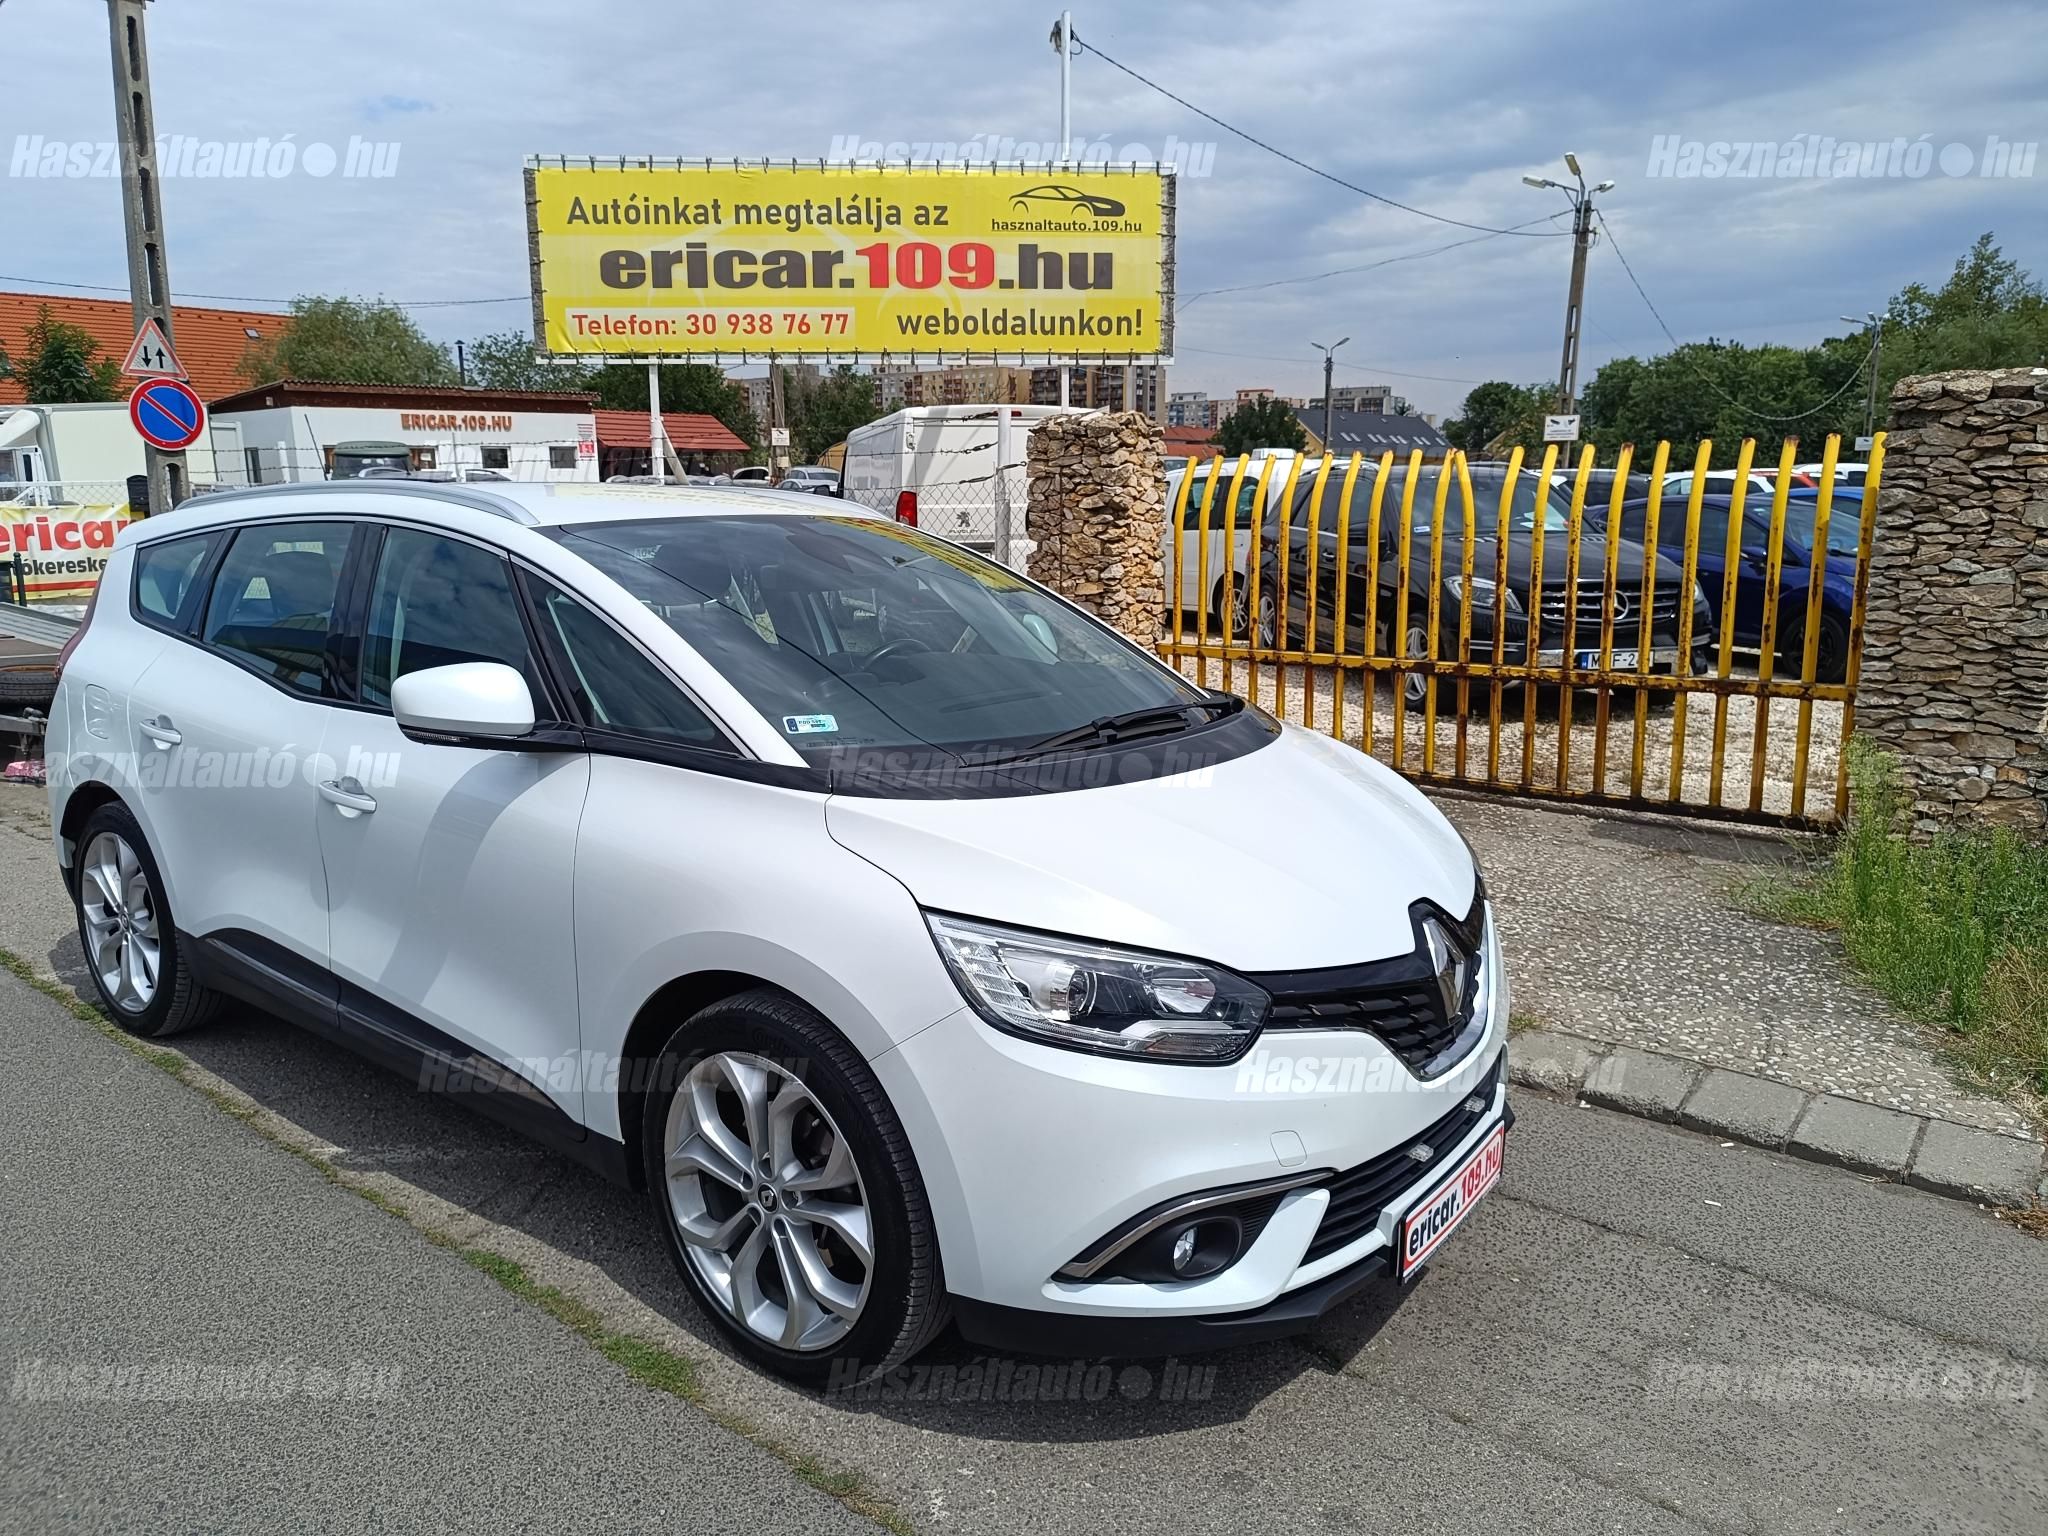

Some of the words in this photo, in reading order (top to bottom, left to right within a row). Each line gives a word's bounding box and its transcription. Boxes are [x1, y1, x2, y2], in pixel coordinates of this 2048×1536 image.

[567, 196, 722, 226] Autóinkat
[734, 193, 902, 234] megtalálja
[914, 203, 949, 226] az
[991, 219, 1143, 232] hasznaltauto.109.hu
[600, 242, 1114, 290] ericar.109.hu
[573, 313, 678, 336] Telefon:
[686, 313, 718, 335] 30
[727, 313, 773, 335] 938
[783, 313, 811, 335] 76
[820, 313, 850, 335] 77
[897, 308, 1143, 337] weboldalunkon!
[401, 413, 513, 432] ERICAR.109.HU
[1409, 1141, 1500, 1257] ericar.109.hu
